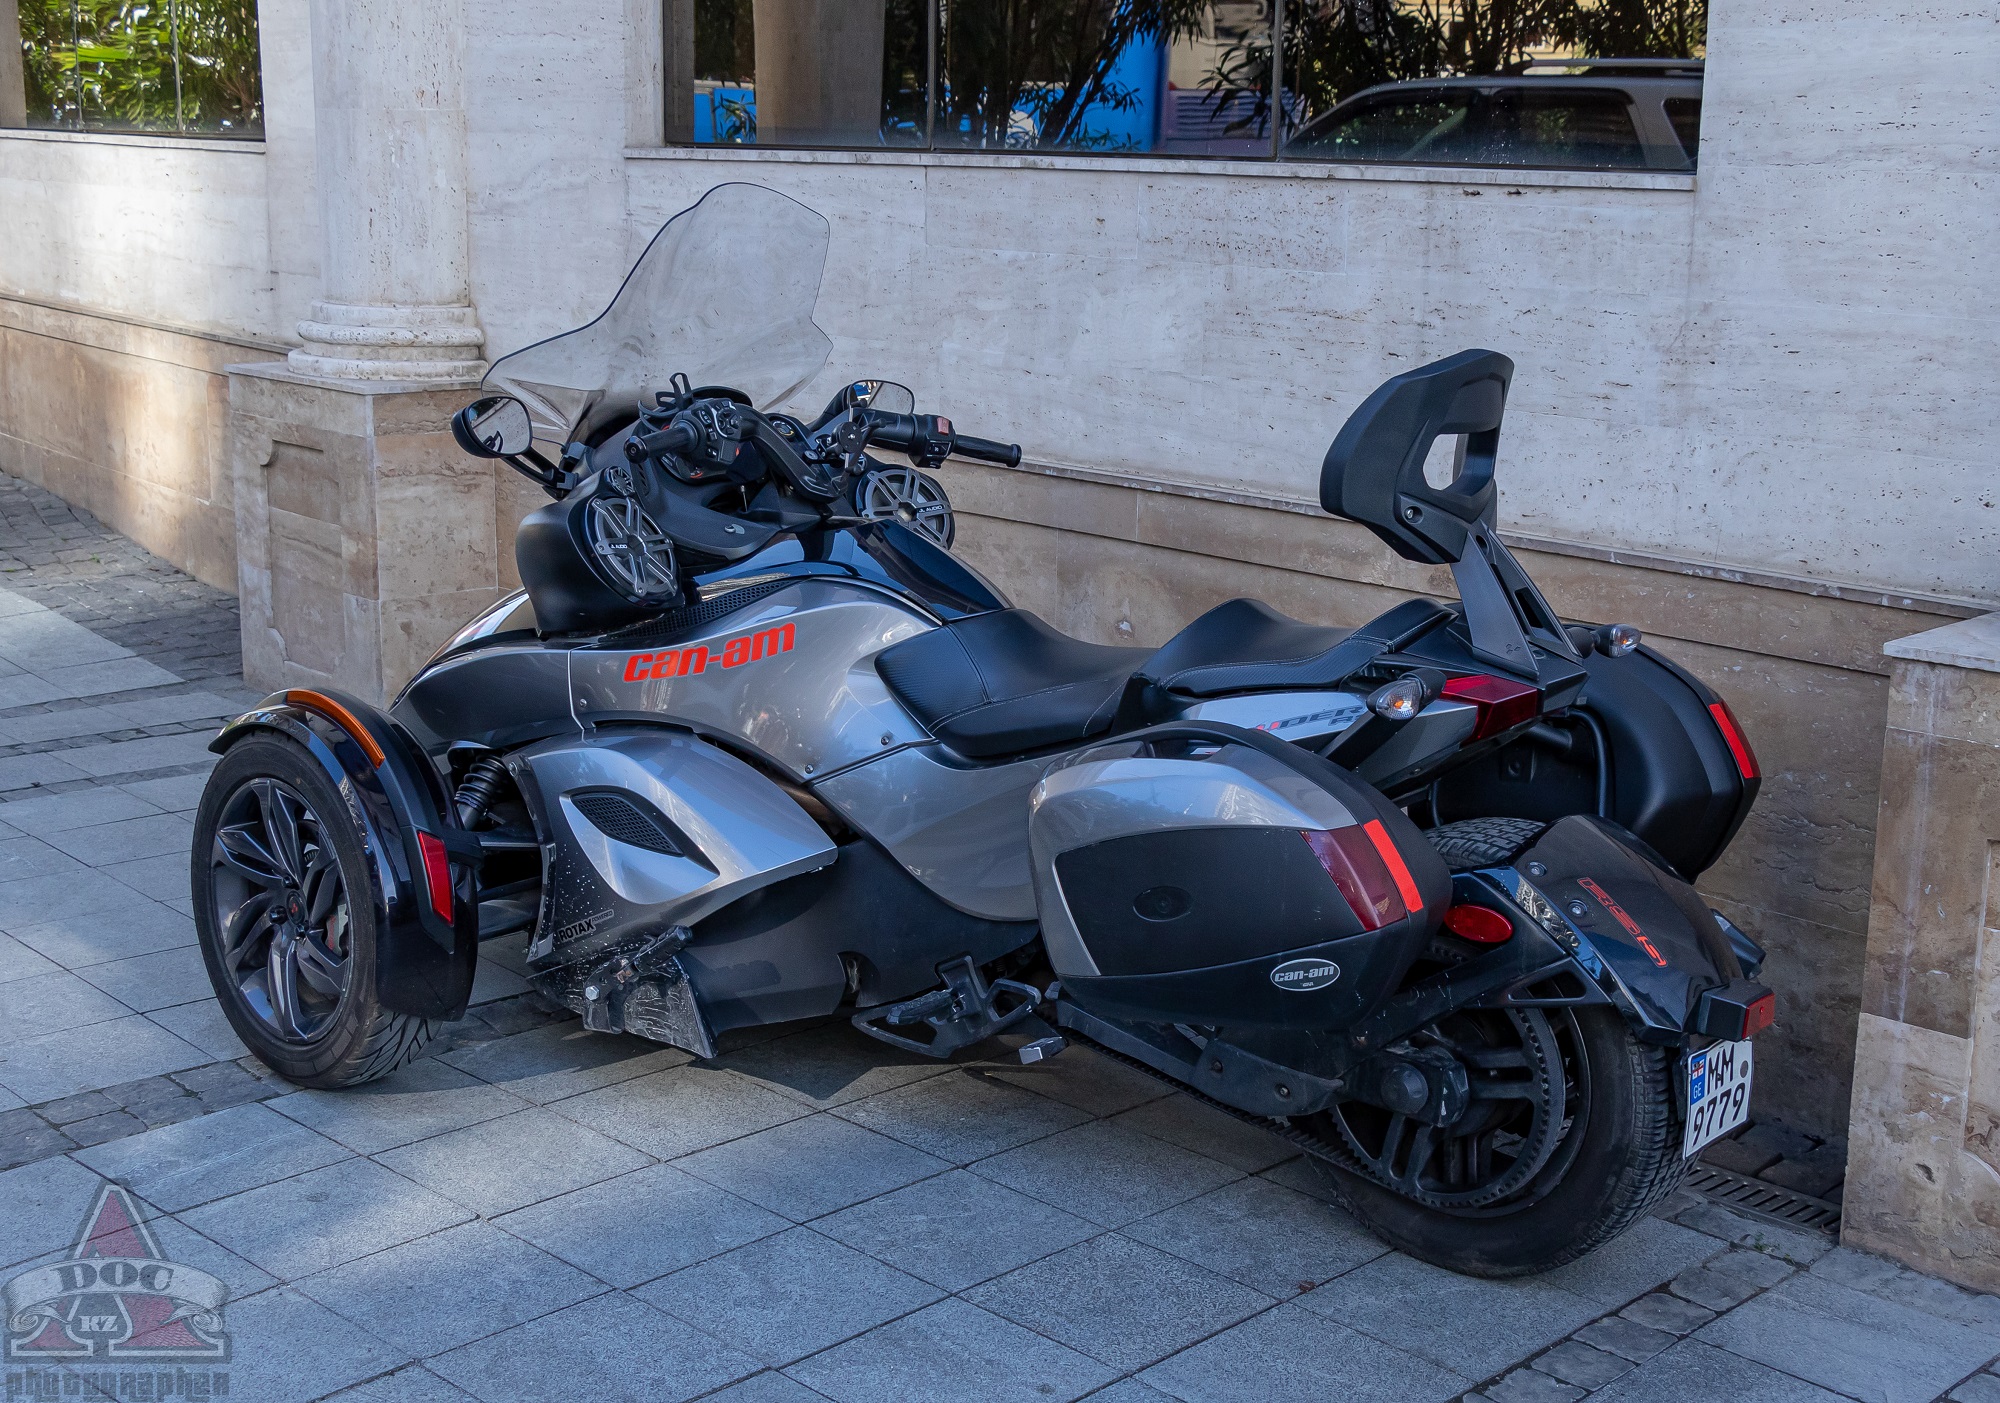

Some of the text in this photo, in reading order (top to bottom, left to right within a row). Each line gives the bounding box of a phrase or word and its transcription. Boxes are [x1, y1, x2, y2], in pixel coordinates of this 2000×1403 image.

[623, 622, 796, 683] can-am
[558, 919, 594, 941] ROTAX
[1274, 966, 1334, 982] can-am
[1693, 1043, 1735, 1099] GE MM
[1692, 1082, 1746, 1147] 9779
